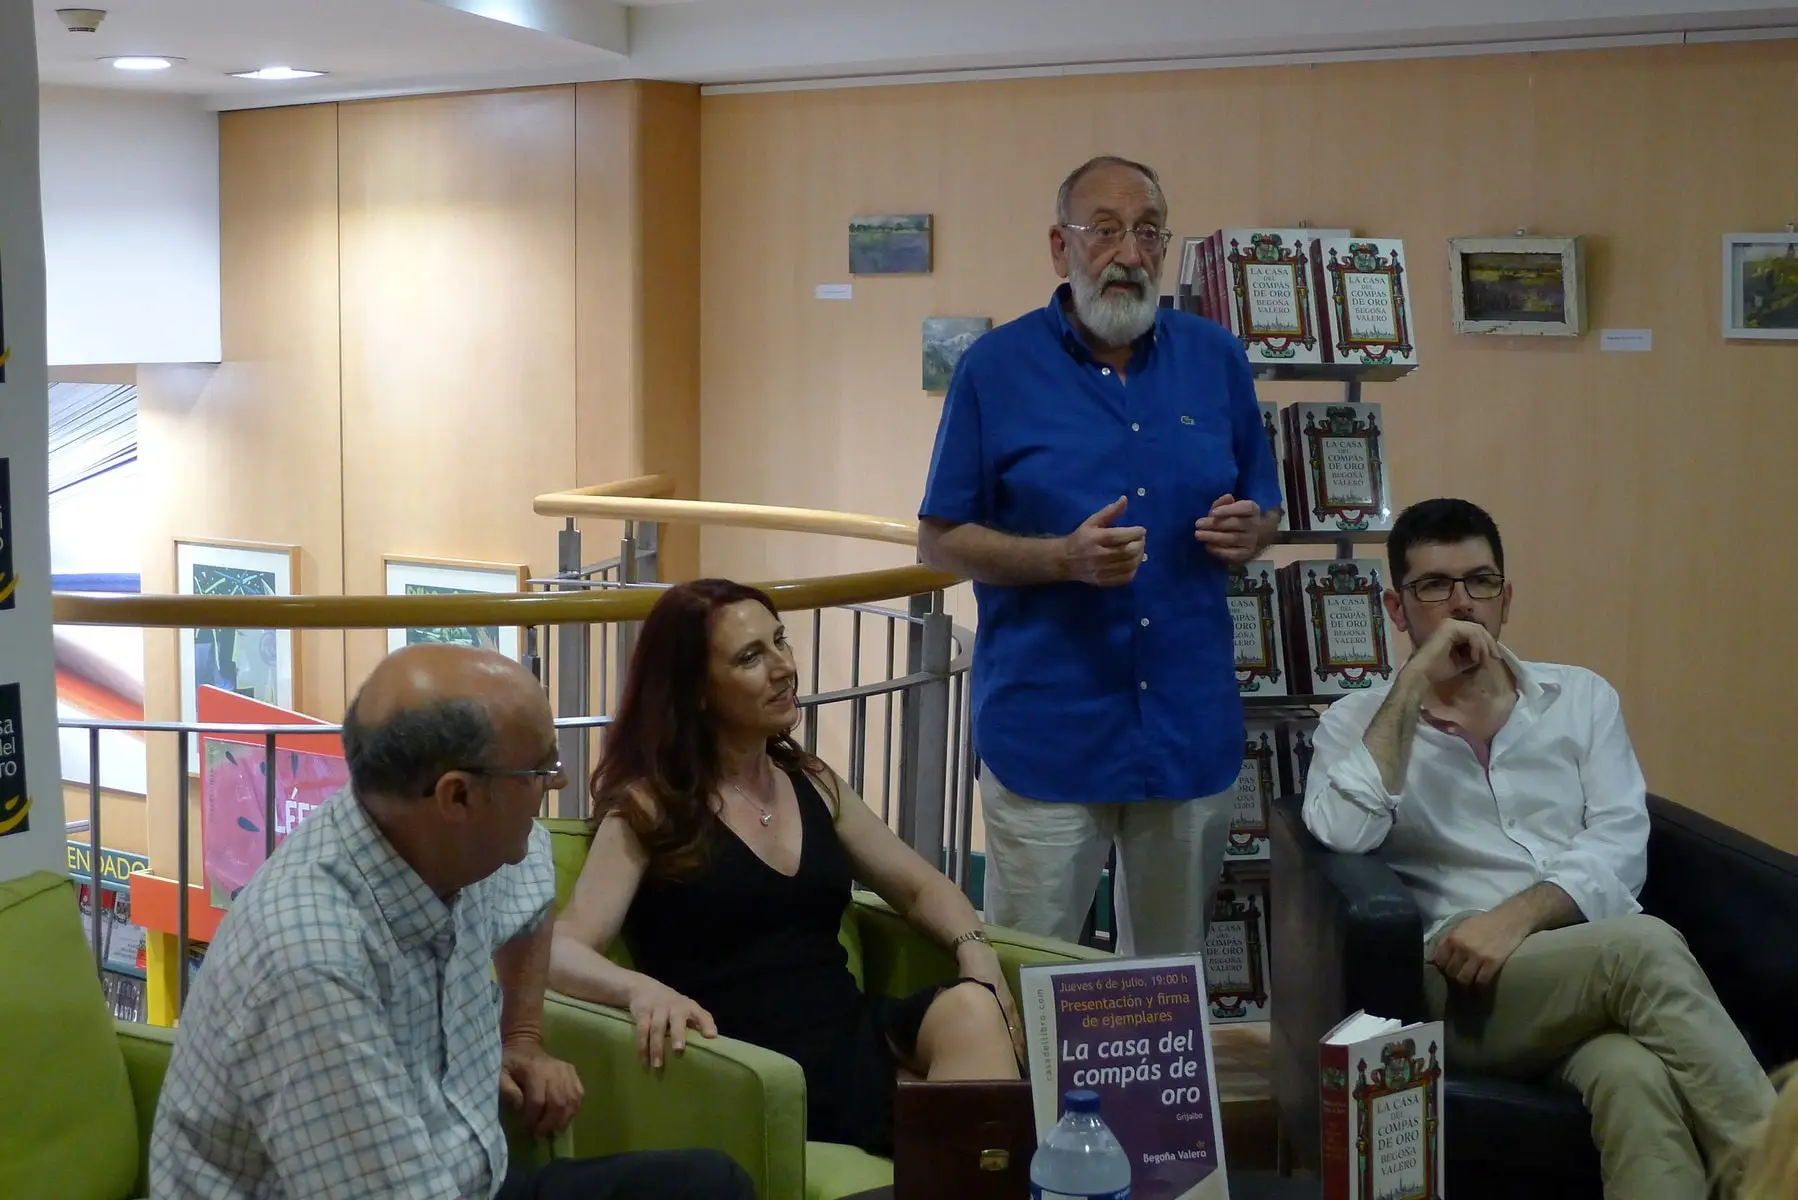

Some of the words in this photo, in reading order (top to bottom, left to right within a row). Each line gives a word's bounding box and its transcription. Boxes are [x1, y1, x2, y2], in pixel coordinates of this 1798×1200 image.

[1264, 268, 1289, 276] CASA
[1348, 276, 1361, 284] LA
[1362, 276, 1386, 285] CASA
[1253, 289, 1267, 297] DE
[1269, 290, 1291, 298] ORO
[1352, 298, 1366, 306] DE
[1367, 298, 1388, 306] ORO
[1325, 440, 1338, 448] LA
[1339, 440, 1363, 449] CASA
[1328, 462, 1343, 470] DE
[1344, 462, 1365, 470] ORO
[1230, 600, 1255, 608] CASA
[1342, 598, 1365, 606] CASA
[1330, 620, 1344, 628] DE
[1346, 620, 1368, 628] ORO
[1335, 636, 1368, 645] VALERO
[1222, 946, 1244, 955] ORO
[1060, 982, 1094, 993] Jueves
[1096, 980, 1103, 990] 6
[1105, 978, 1118, 989] de
[1152, 974, 1179, 986] 19:00
[1180, 973, 1188, 984] h
[1061, 995, 1143, 1013] Presentación
[1146, 996, 1154, 1008] y
[1156, 992, 1190, 1005] firma
[1082, 1016, 1098, 1028] de
[1102, 1010, 1174, 1028] ejemplares
[1062, 1039, 1089, 1062] La
[1097, 1037, 1150, 1059] casa
[1158, 1029, 1194, 1053] del
[1072, 1058, 1162, 1088] compás
[1169, 1056, 1198, 1078] de
[1161, 1086, 1201, 1106] oro
[1377, 1101, 1391, 1114] LA
[1392, 1094, 1420, 1110] CASA
[1378, 1137, 1393, 1151] DE
[1395, 1129, 1420, 1146] ORO
[1143, 1152, 1176, 1164] Begoña
[1178, 1149, 1208, 1160] Valero
[1380, 1157, 1418, 1176] VALERO
